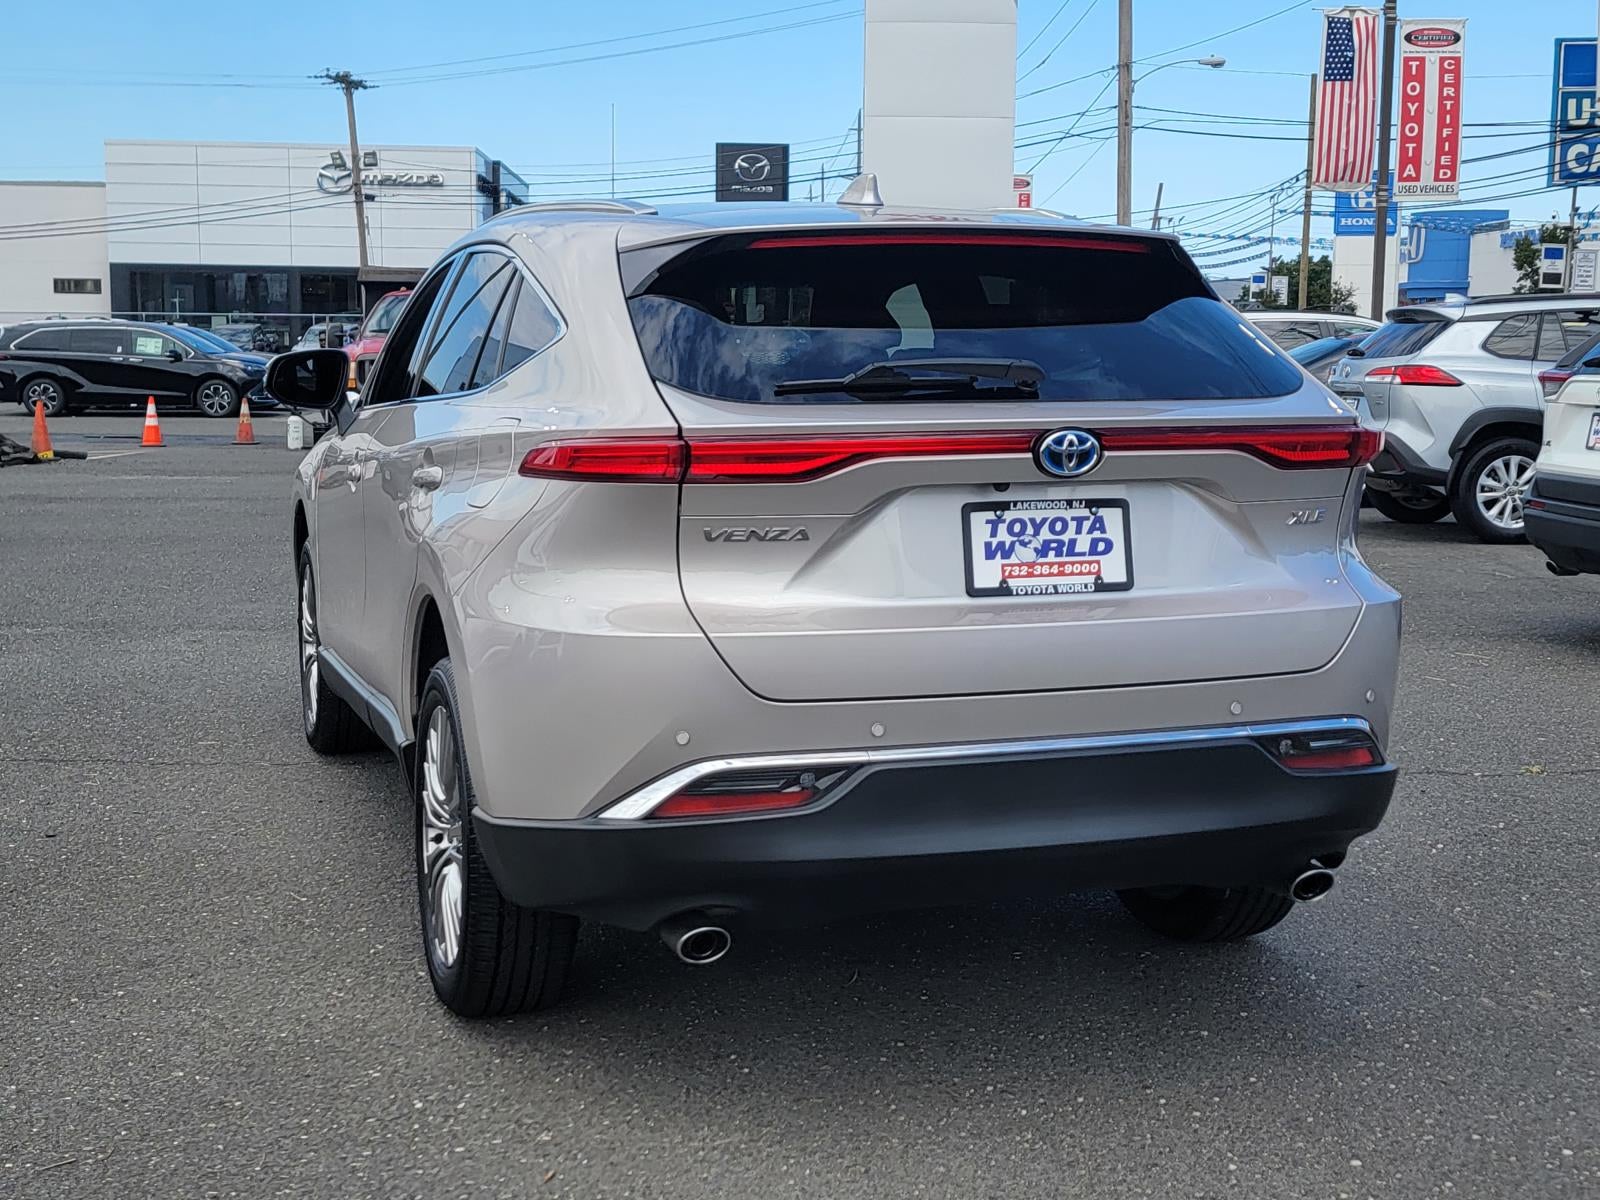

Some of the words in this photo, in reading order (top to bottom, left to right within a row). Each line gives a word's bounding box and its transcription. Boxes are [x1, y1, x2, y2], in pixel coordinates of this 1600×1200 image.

[1402, 61, 1420, 178] TOYOTA
[1439, 59, 1456, 179] CERTIFIED
[1567, 98, 1600, 126] U
[1398, 184, 1419, 194] USED
[1419, 184, 1455, 194] VEHICLES
[1340, 217, 1395, 226] HONA
[1010, 500, 1069, 511] LAKEWOOD,
[1072, 500, 1086, 509] NJ
[1286, 509, 1326, 525] XLE
[985, 515, 1107, 538] TOYOTA
[703, 527, 810, 542] VENZA
[1003, 563, 1099, 577] 732-364-9000
[1011, 585, 1055, 596] TOYOTA
[1057, 583, 1096, 593] WORLD
